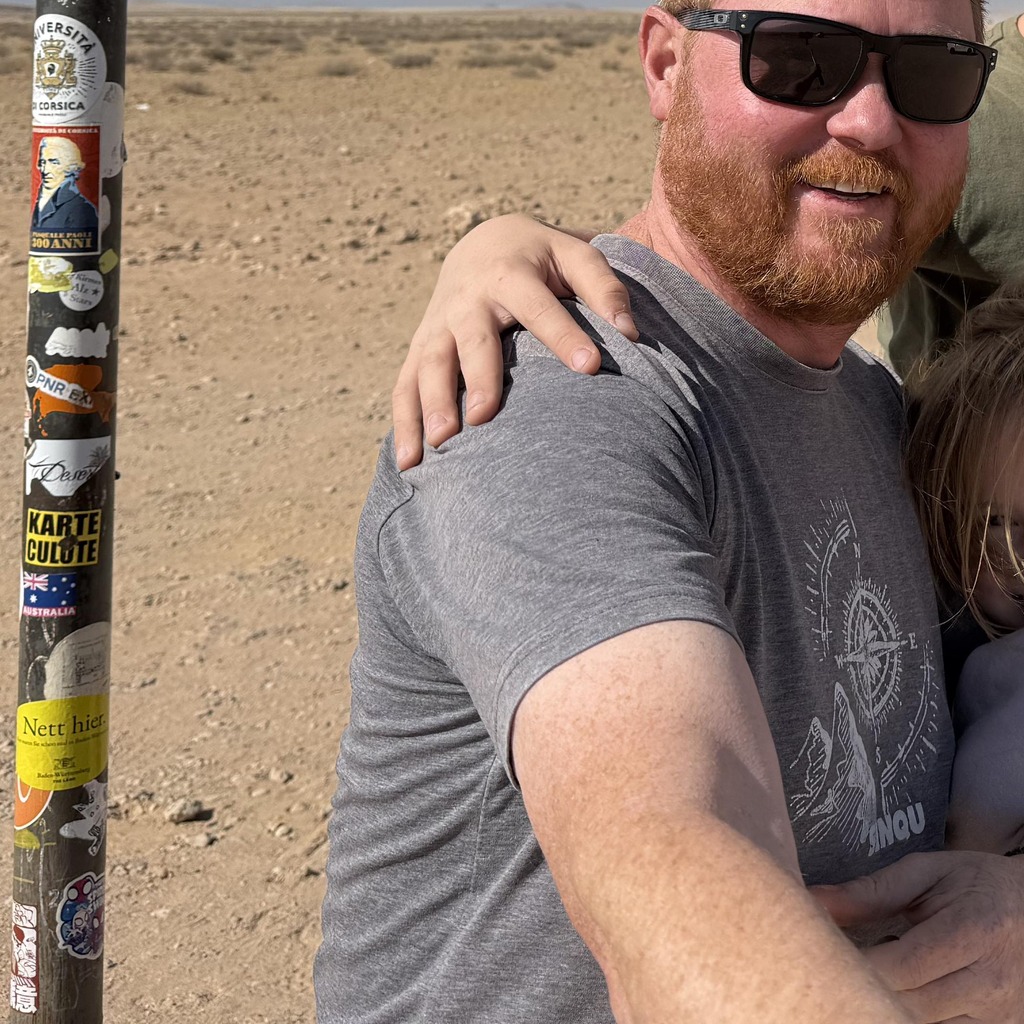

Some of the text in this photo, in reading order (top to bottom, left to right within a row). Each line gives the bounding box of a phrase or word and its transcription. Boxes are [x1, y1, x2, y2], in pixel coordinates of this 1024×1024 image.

[39, 101, 86, 111] CORSICA
[51, 238, 92, 248] ANNI
[36, 372, 65, 396] PNR
[28, 511, 99, 535] KARTE
[23, 607, 76, 616] AUSTRALIA
[909, 632, 918, 651] E
[23, 713, 106, 736] Nett hier.
